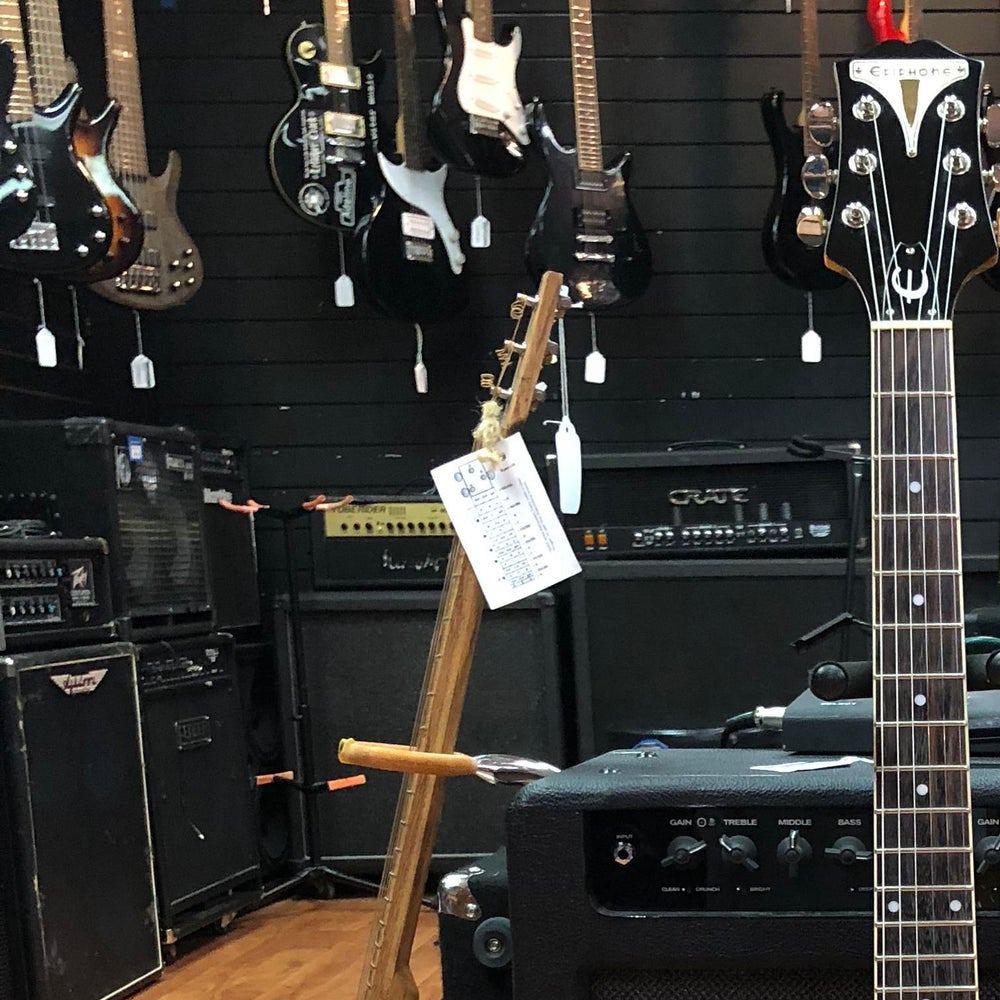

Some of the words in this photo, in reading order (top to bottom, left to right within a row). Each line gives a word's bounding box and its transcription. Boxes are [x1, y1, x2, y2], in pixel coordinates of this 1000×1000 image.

[669, 487, 750, 505] CRATE
[723, 818, 758, 826] TREBLE
[778, 818, 812, 826] MIDDLE
[838, 818, 862, 826] BASS
[977, 818, 1000, 826] GAIN
